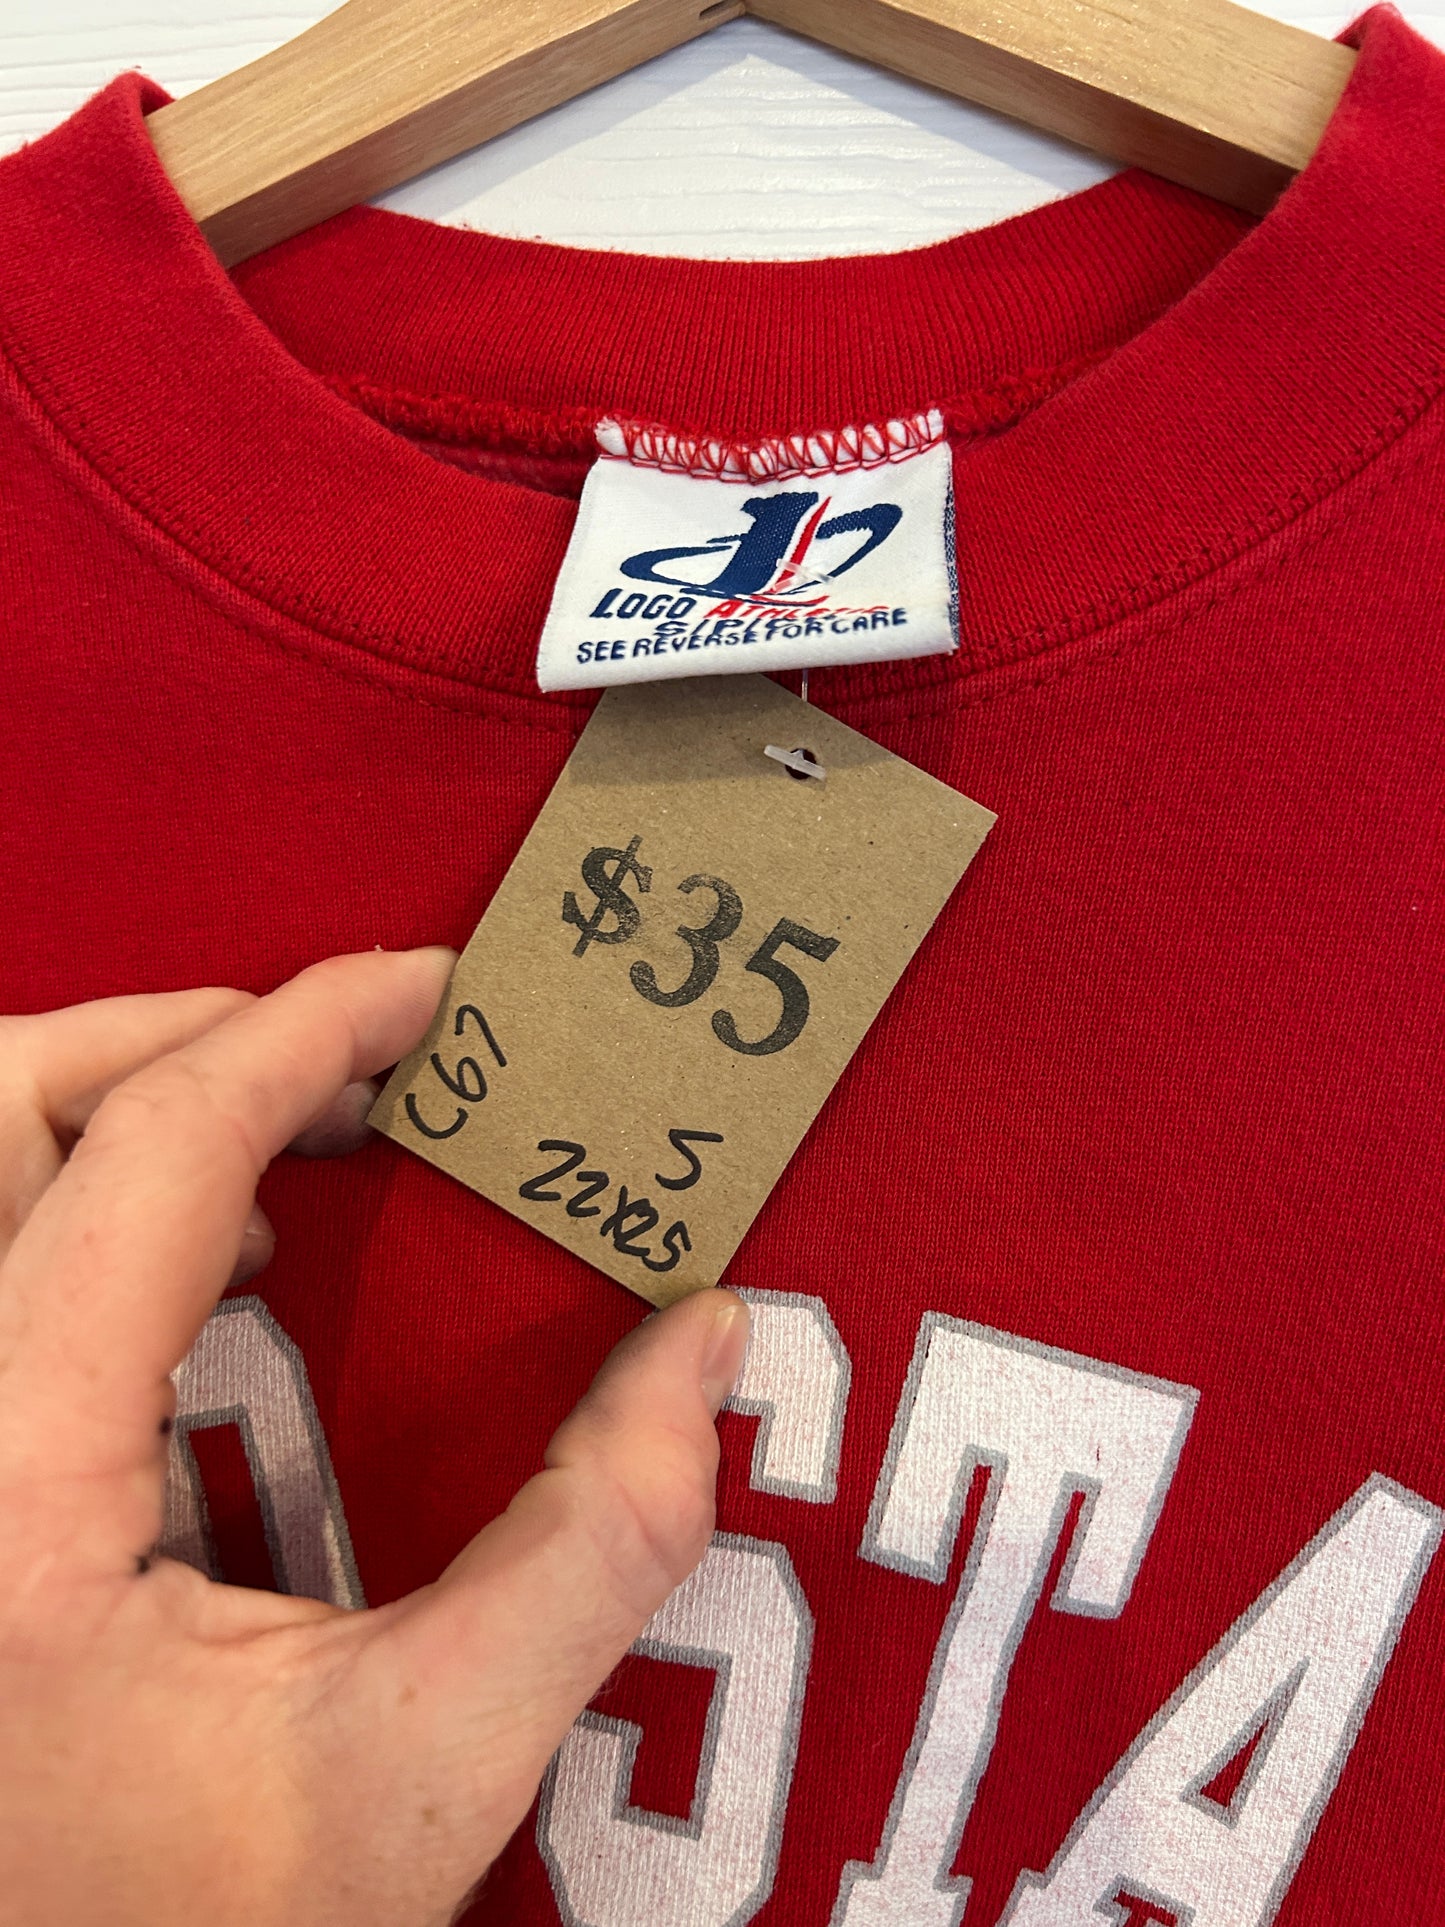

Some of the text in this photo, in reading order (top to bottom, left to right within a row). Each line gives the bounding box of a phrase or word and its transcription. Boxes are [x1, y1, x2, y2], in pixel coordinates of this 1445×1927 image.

[576, 608, 908, 664] SEE REVERSE FOR CARE
[589, 587, 890, 619] LOGO ATHLE
[562, 835, 841, 1056] $35
[405, 1004, 507, 1139] C67
